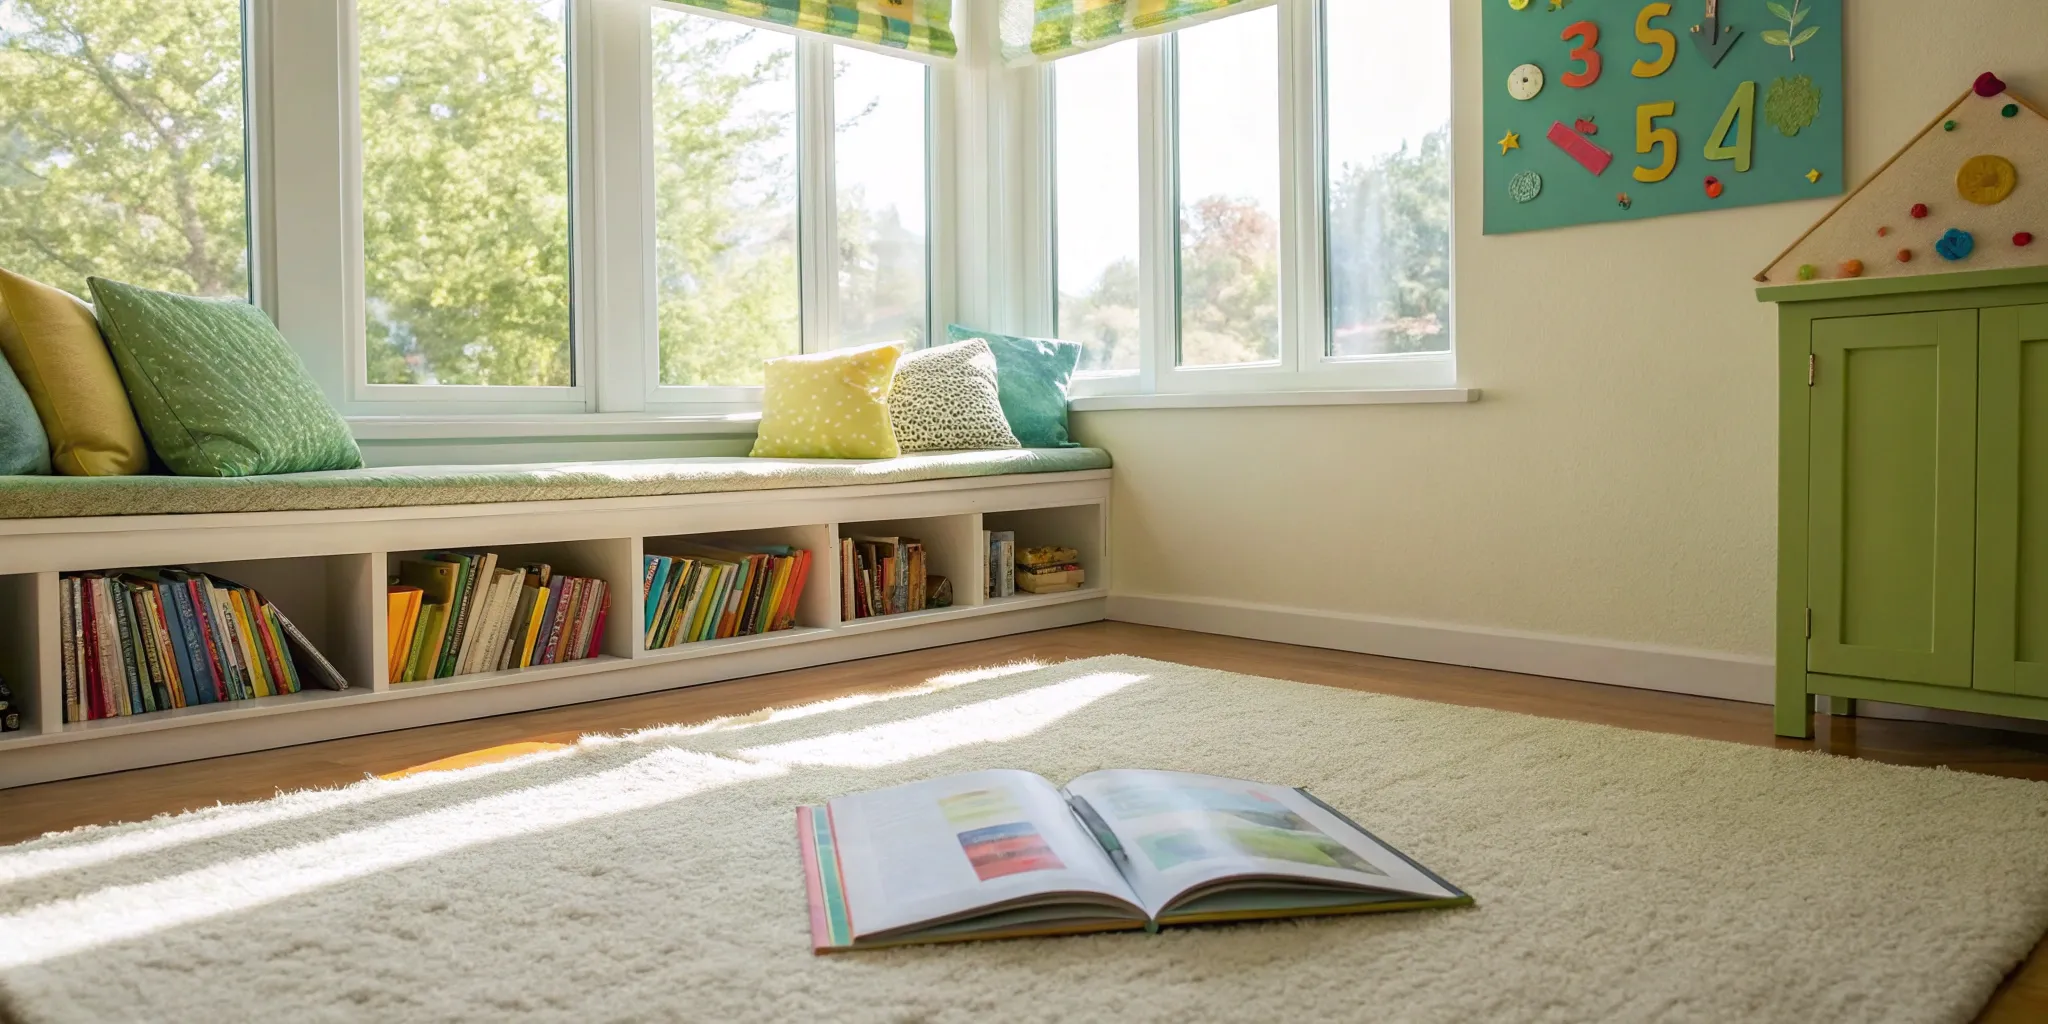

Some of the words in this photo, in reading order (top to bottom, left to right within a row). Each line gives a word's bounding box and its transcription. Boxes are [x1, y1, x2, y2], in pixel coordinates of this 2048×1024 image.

[1561, 21, 1603, 88] 3
[1633, 101, 1678, 183] 5
[1705, 81, 1755, 172] 4
